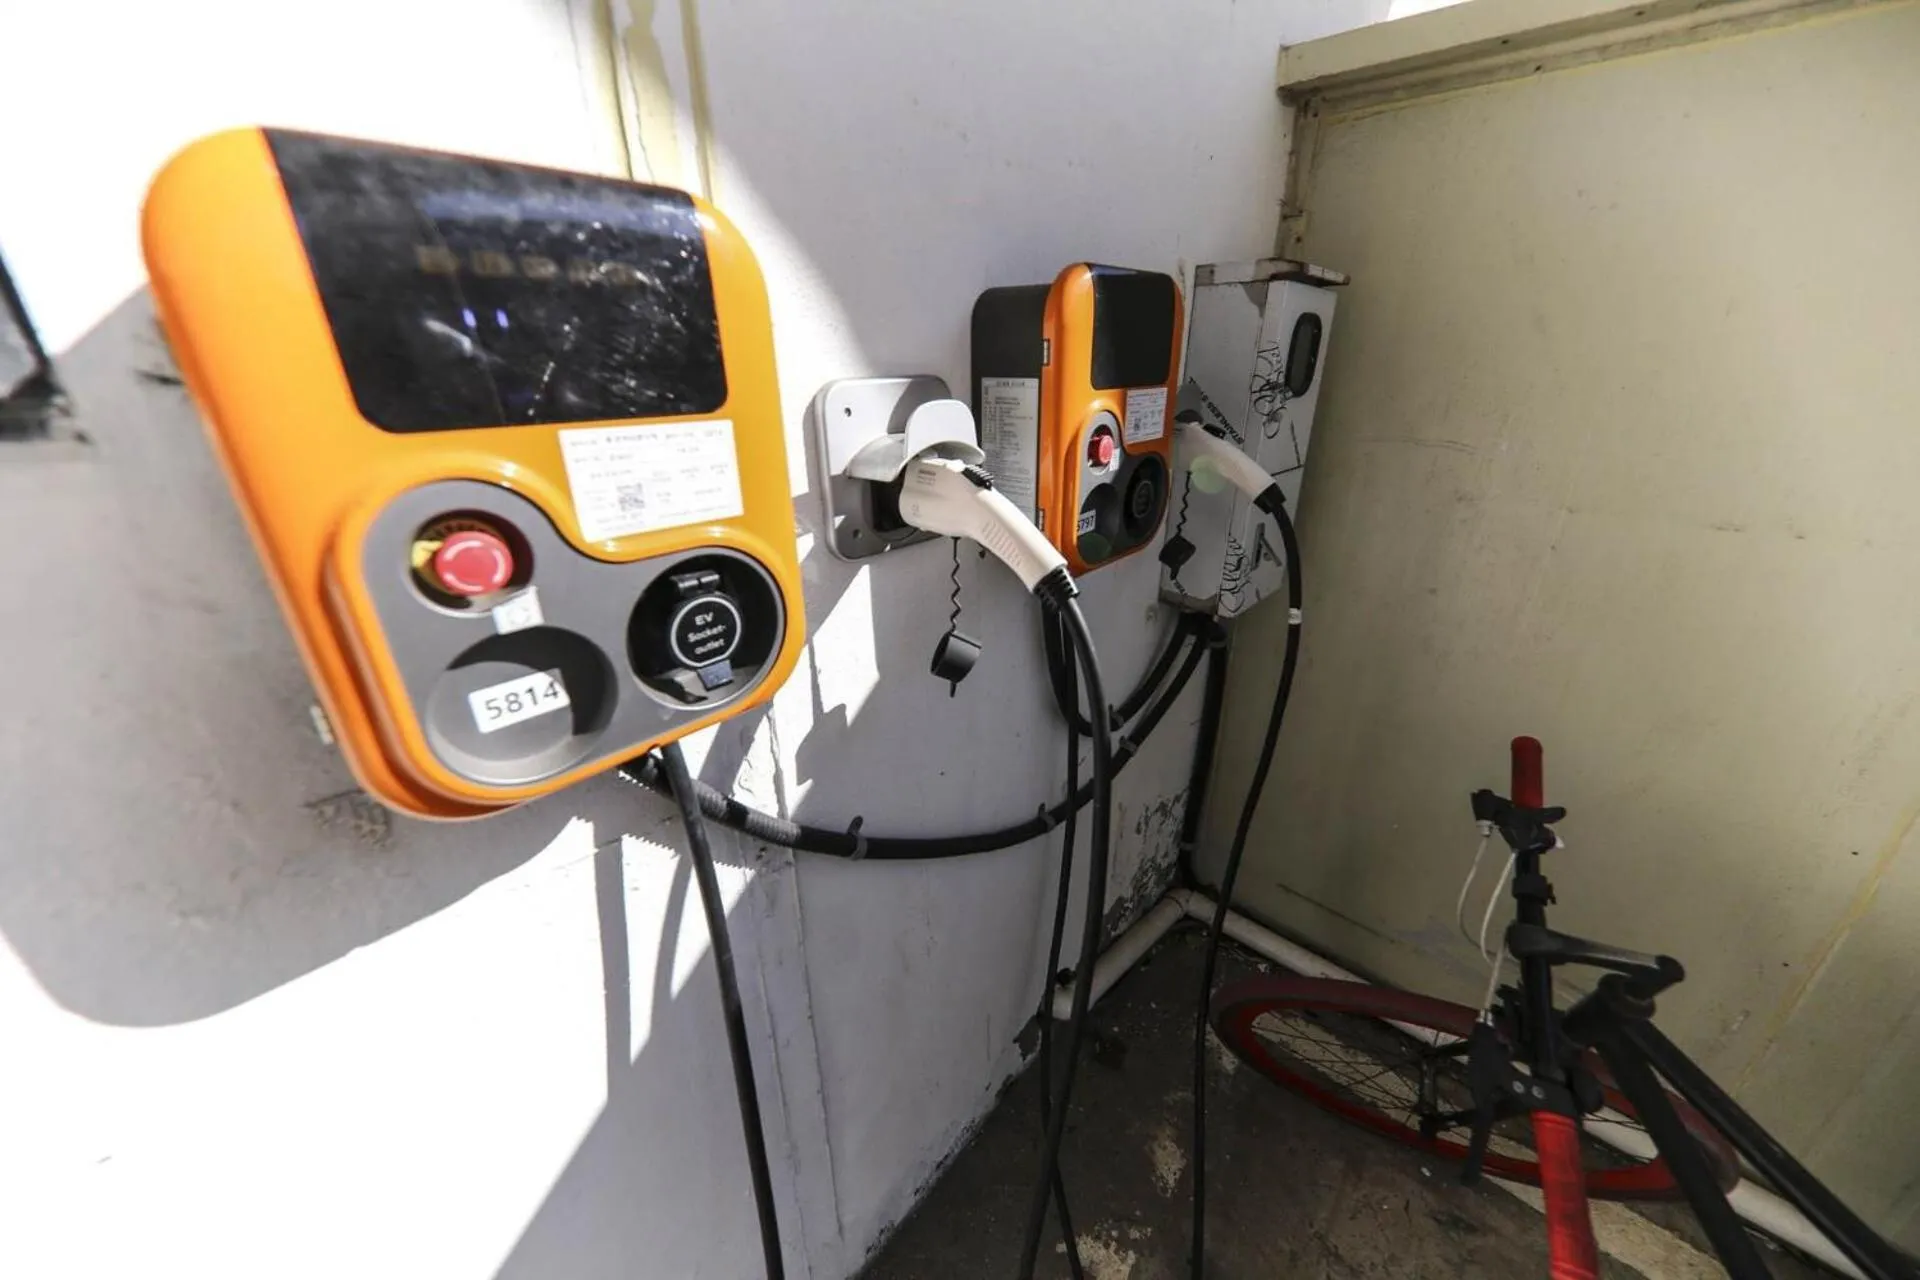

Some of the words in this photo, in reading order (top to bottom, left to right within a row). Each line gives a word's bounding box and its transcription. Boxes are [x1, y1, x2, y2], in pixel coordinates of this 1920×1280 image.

[694, 611, 714, 626] EV
[687, 624, 727, 643] Socket-
[694, 638, 725, 655] outlet
[484, 680, 560, 722] 5814
